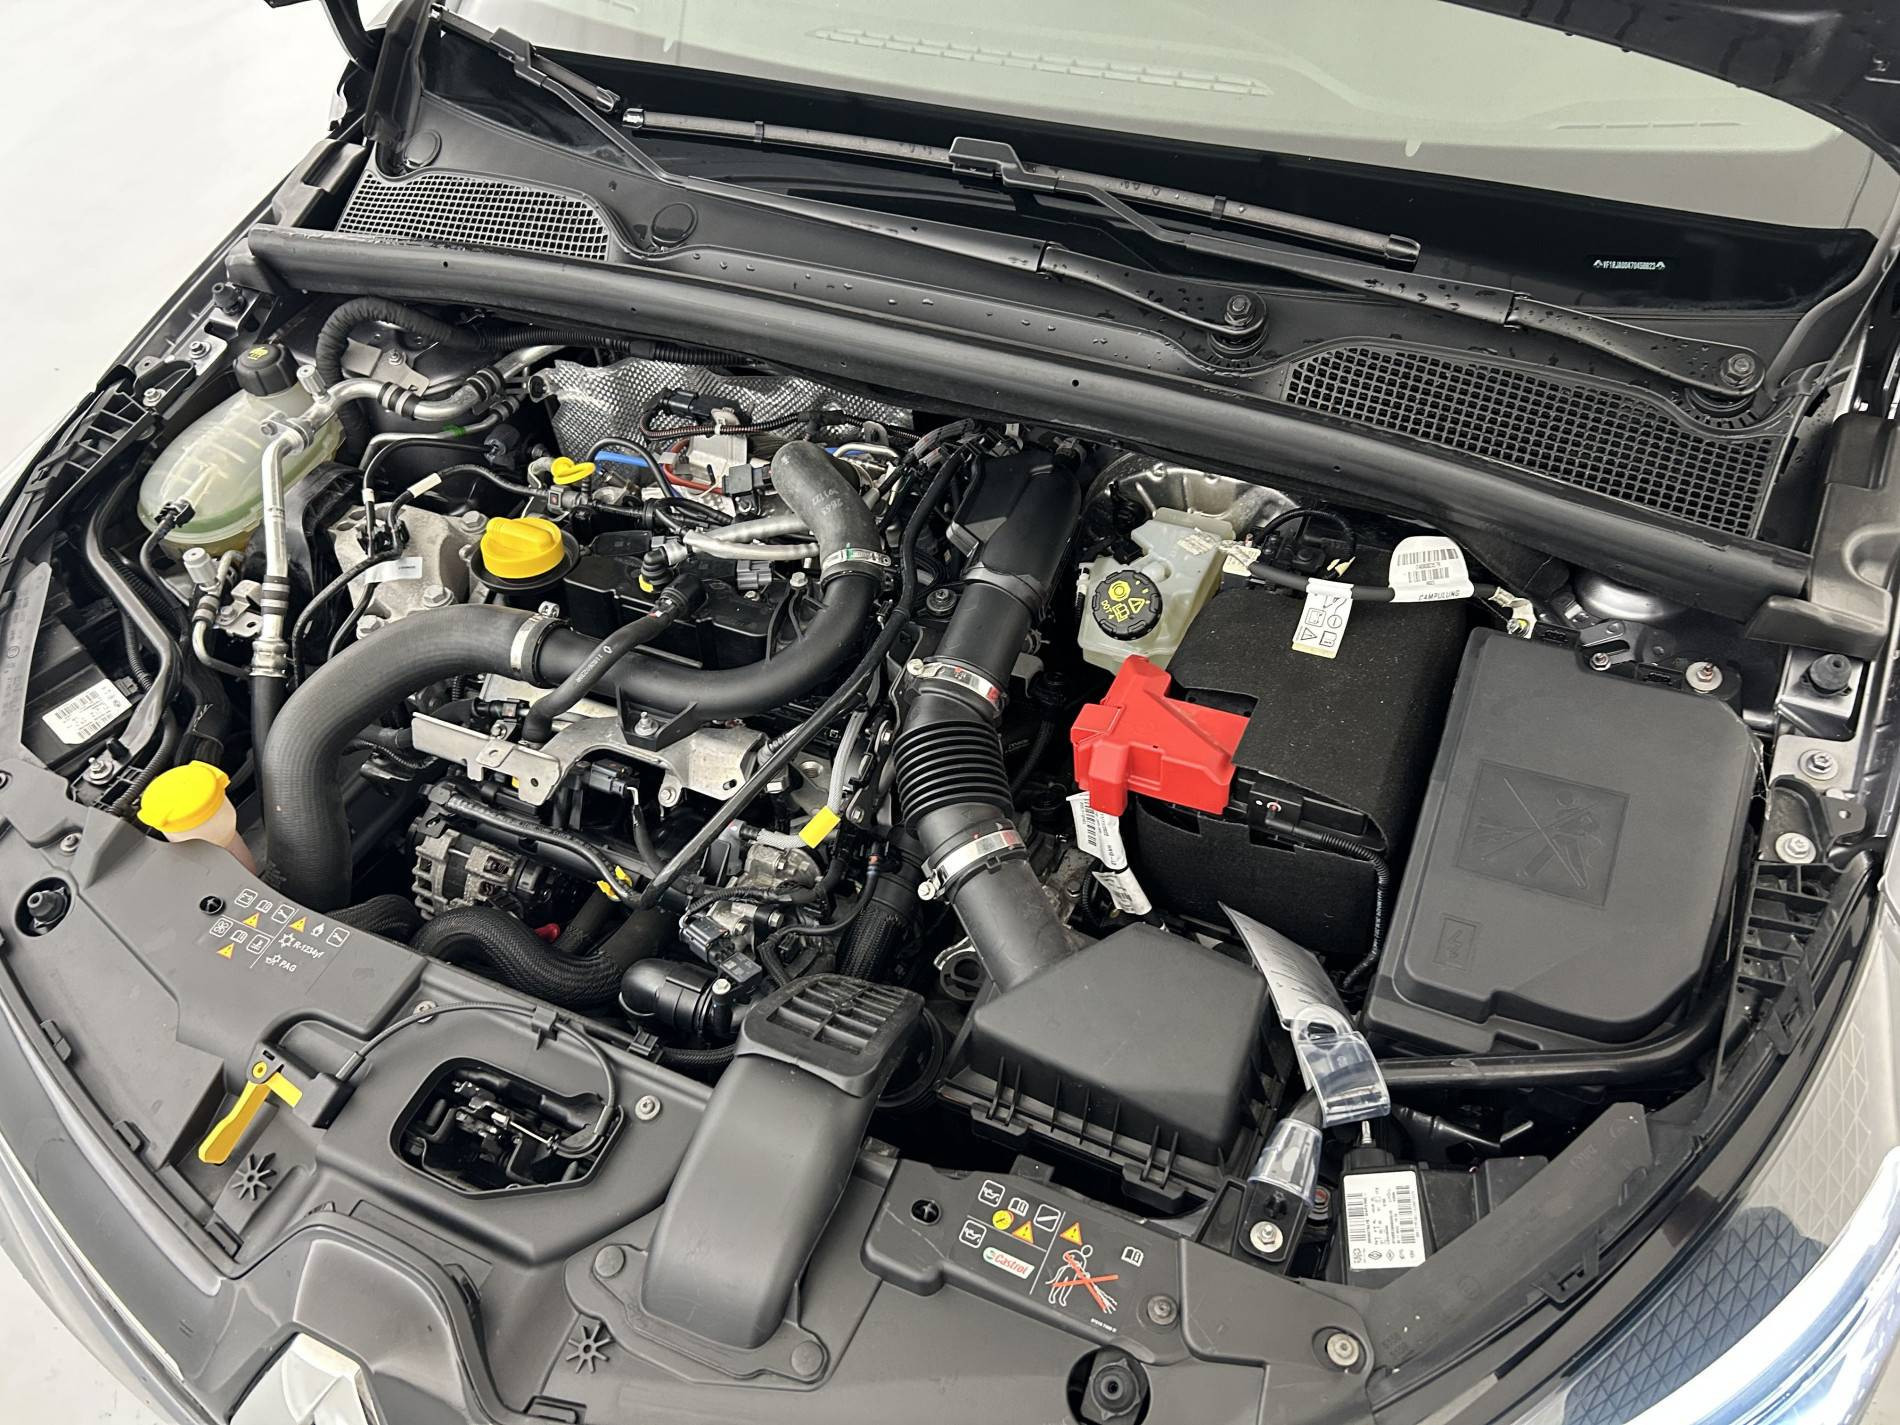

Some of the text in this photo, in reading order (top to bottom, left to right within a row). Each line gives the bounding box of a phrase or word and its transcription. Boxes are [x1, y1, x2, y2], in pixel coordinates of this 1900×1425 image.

[1101, 600, 1113, 613] DOT
[292, 940, 325, 958] R-1234yf
[279, 960, 297, 972] PAG
[994, 1253, 1029, 1275] Castrol
